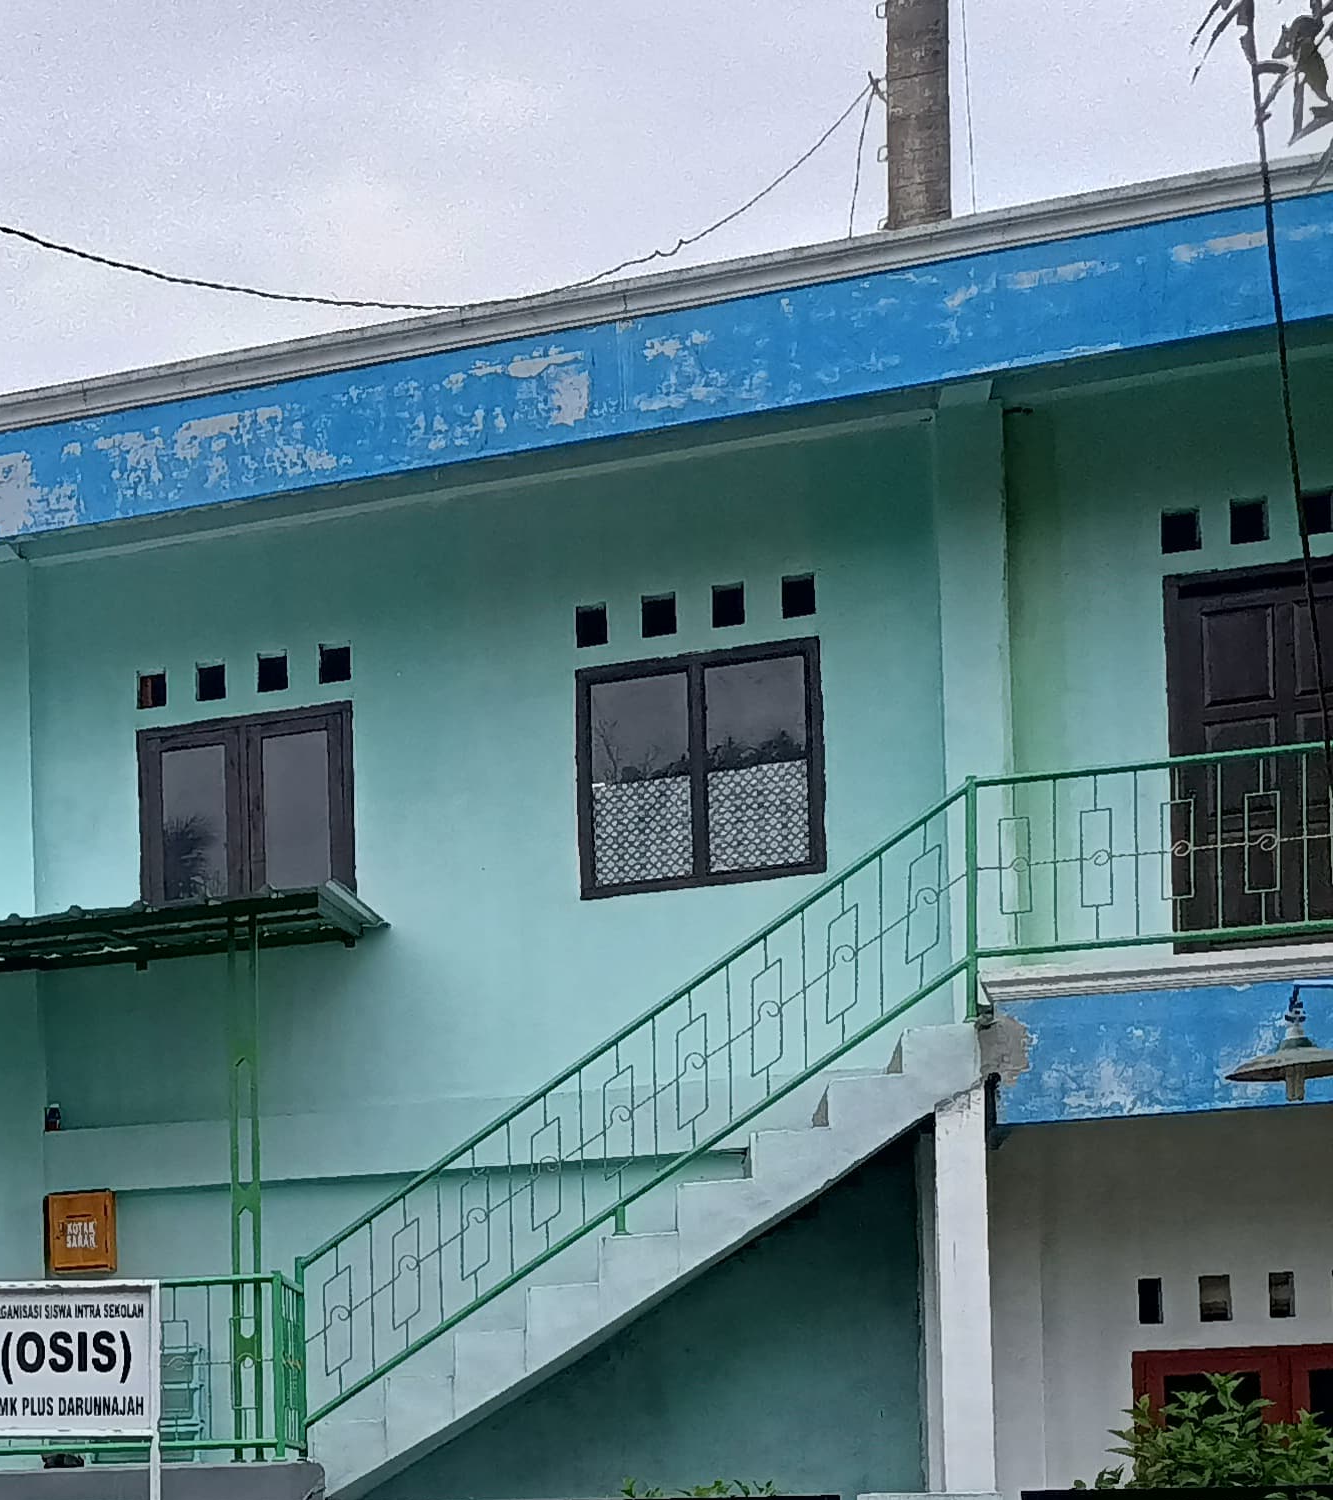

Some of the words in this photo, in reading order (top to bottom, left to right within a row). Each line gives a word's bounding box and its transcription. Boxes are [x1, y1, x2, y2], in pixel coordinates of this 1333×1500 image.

[67, 1221, 97, 1235] KOTAK
[66, 1235, 97, 1248] SARAN
[45, 1304, 72, 1319] SISWA
[74, 1303, 101, 1319] INTRA
[103, 1303, 144, 1318] SEKOLAH
[1, 1330, 132, 1385] (OSIS)
[22, 1397, 54, 1417] PLUS
[58, 1396, 144, 1417] DARUNNAJAH
